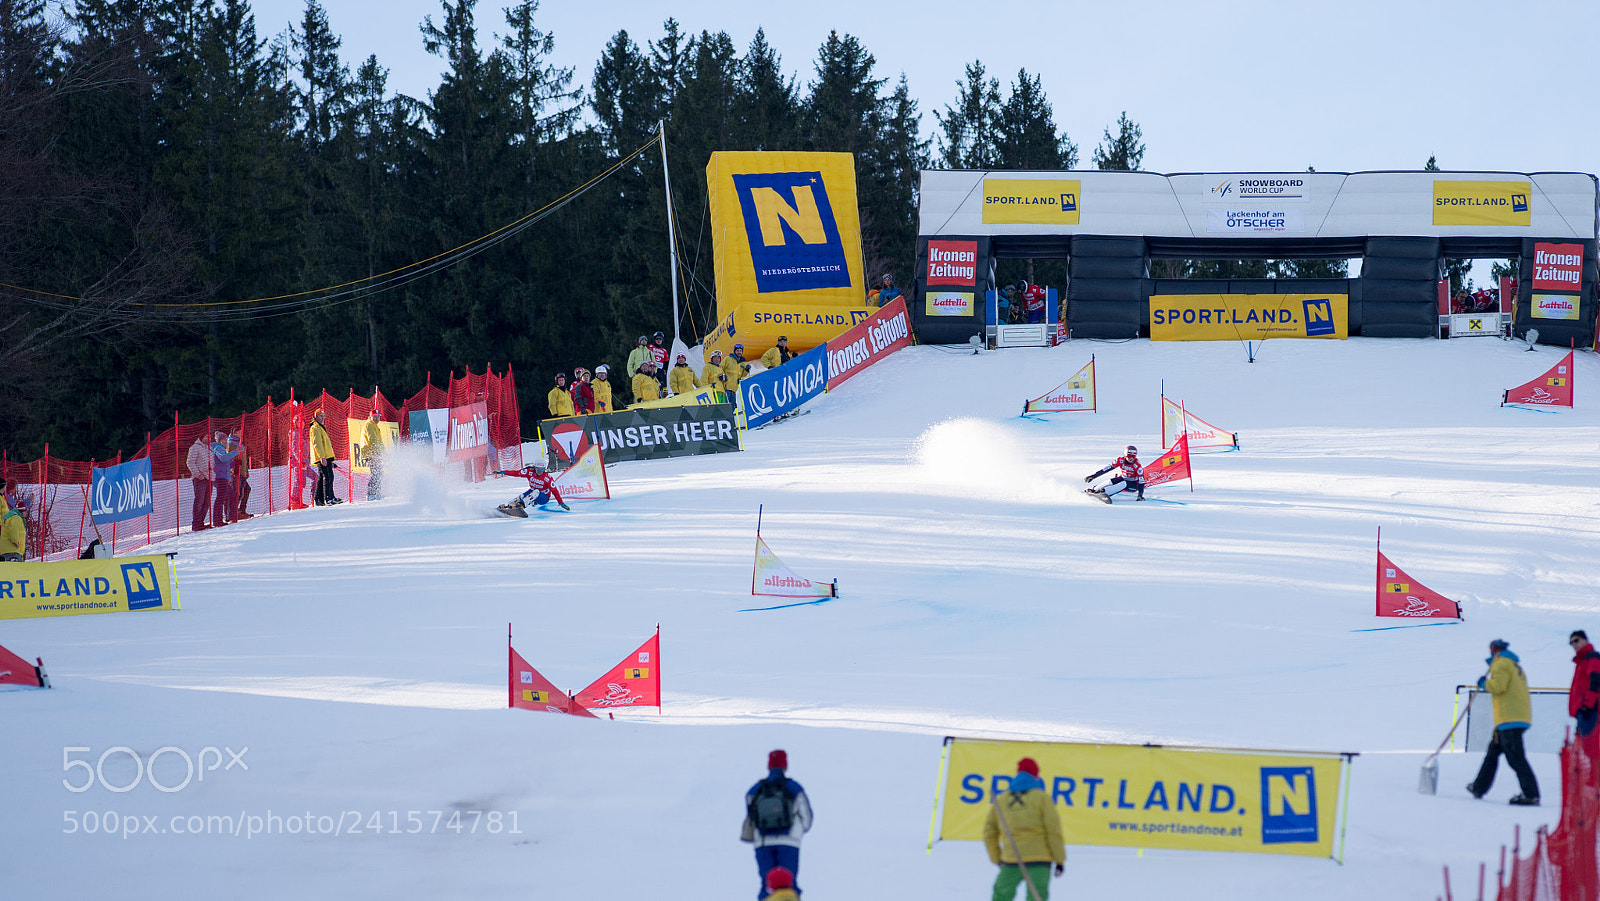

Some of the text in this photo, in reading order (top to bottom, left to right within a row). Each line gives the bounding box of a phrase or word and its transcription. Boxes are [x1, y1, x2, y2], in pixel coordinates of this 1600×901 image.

[985, 196, 1058, 205] SPORT.LAND.
[1436, 198, 1510, 206] SPORT.LAND.
[750, 185, 828, 246] N
[1226, 218, 1285, 228] ÖTSCHER
[930, 248, 975, 262] Kronen
[1536, 250, 1581, 266] Kronen
[762, 264, 841, 276] NIEDERÖSTERREICH
[930, 263, 974, 280] Zeitung
[1535, 266, 1580, 284] Zeitung
[933, 298, 967, 307] Lattella
[1538, 300, 1573, 310] Lattella
[754, 312, 849, 326] SPORT.LAND.
[1153, 308, 1298, 324] SPORT.LAND.
[868, 310, 909, 355] Zeitung
[826, 336, 870, 380] Kronen
[774, 358, 825, 408] UNIQA
[1044, 394, 1084, 404] Lattella
[450, 417, 477, 451] Kronen
[591, 420, 733, 450] UNSER HEER
[116, 472, 152, 514] UNIQA
[36, 601, 118, 611] www.sportlandnoe.at
[1108, 820, 1243, 838] www.sportlandnoe.at
